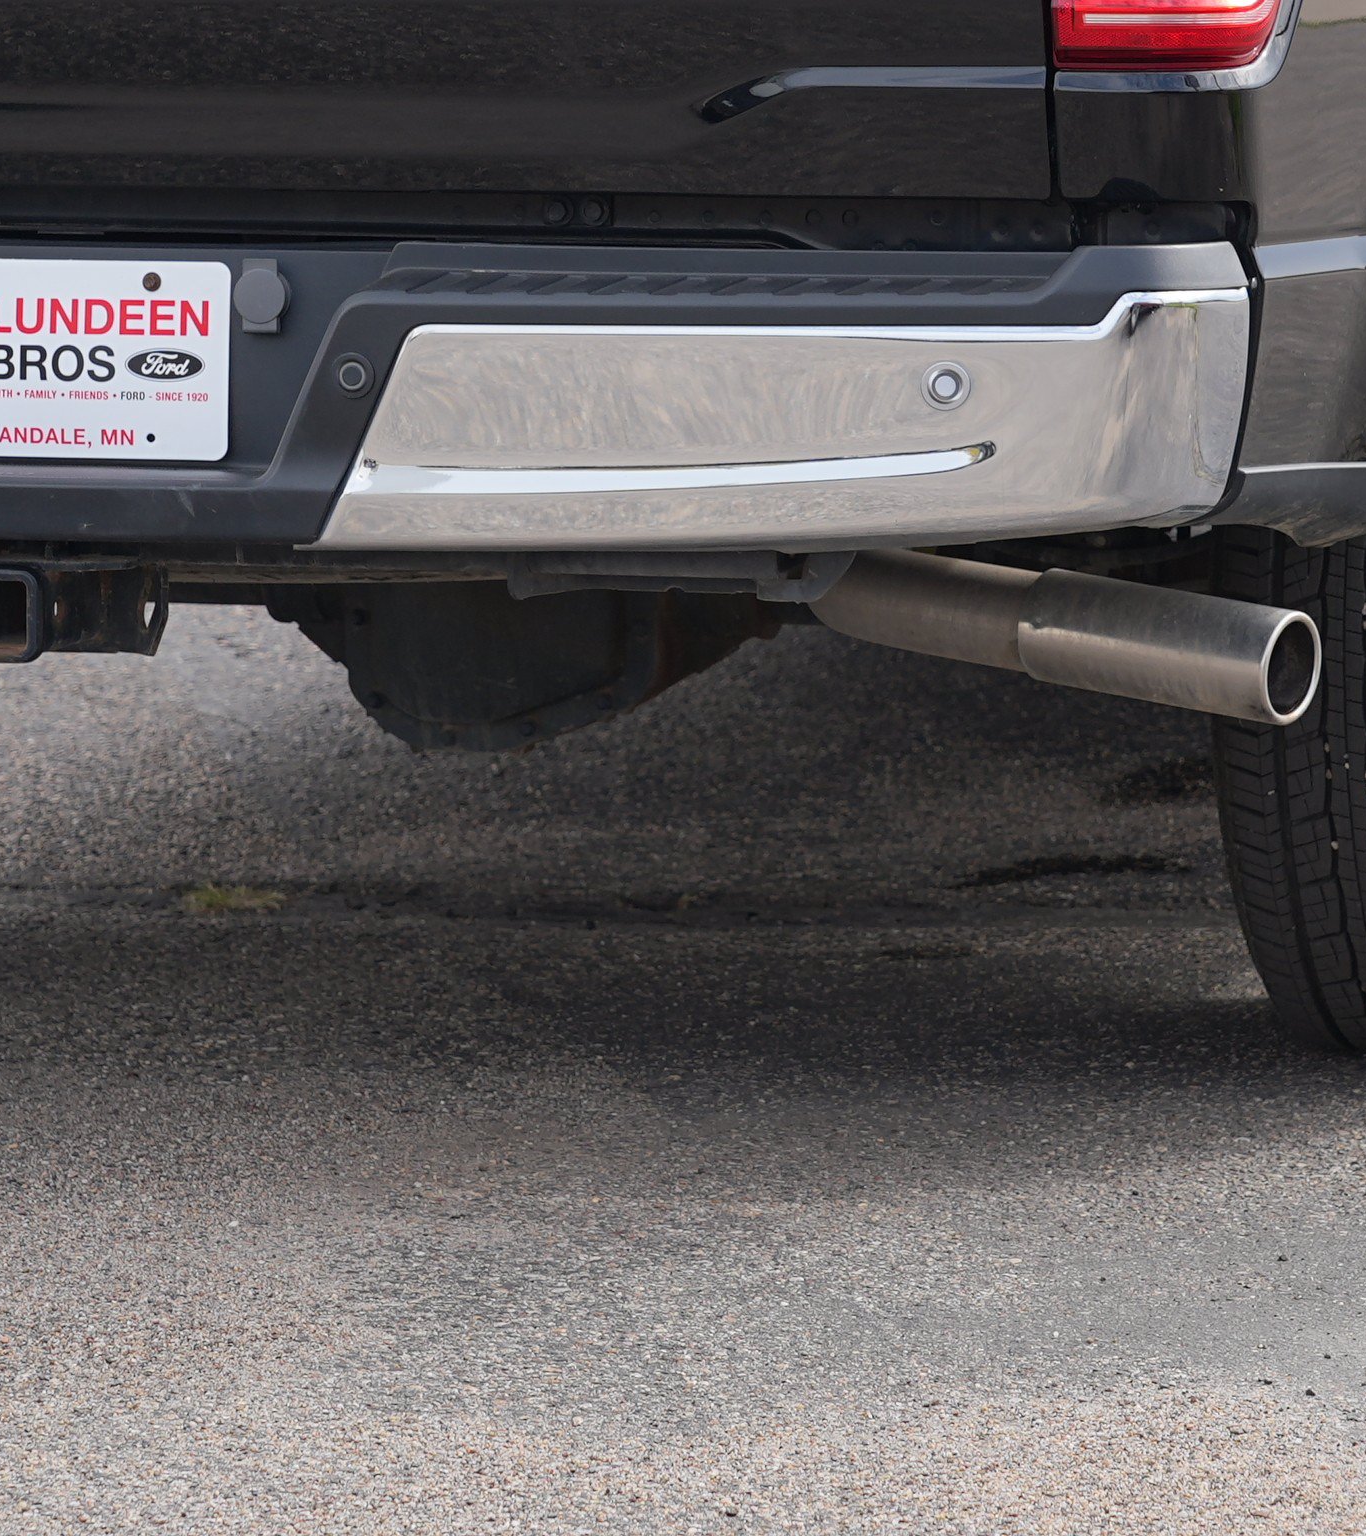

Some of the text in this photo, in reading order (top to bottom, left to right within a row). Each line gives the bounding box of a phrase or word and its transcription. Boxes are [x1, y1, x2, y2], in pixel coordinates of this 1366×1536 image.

[140, 352, 191, 378] Ford
[24, 389, 57, 400] FAMILY
[69, 390, 109, 401] FRIENDS
[120, 391, 146, 401] FORD
[155, 392, 183, 402] SINCE
[187, 392, 209, 402] 1920
[101, 429, 135, 446] MN
